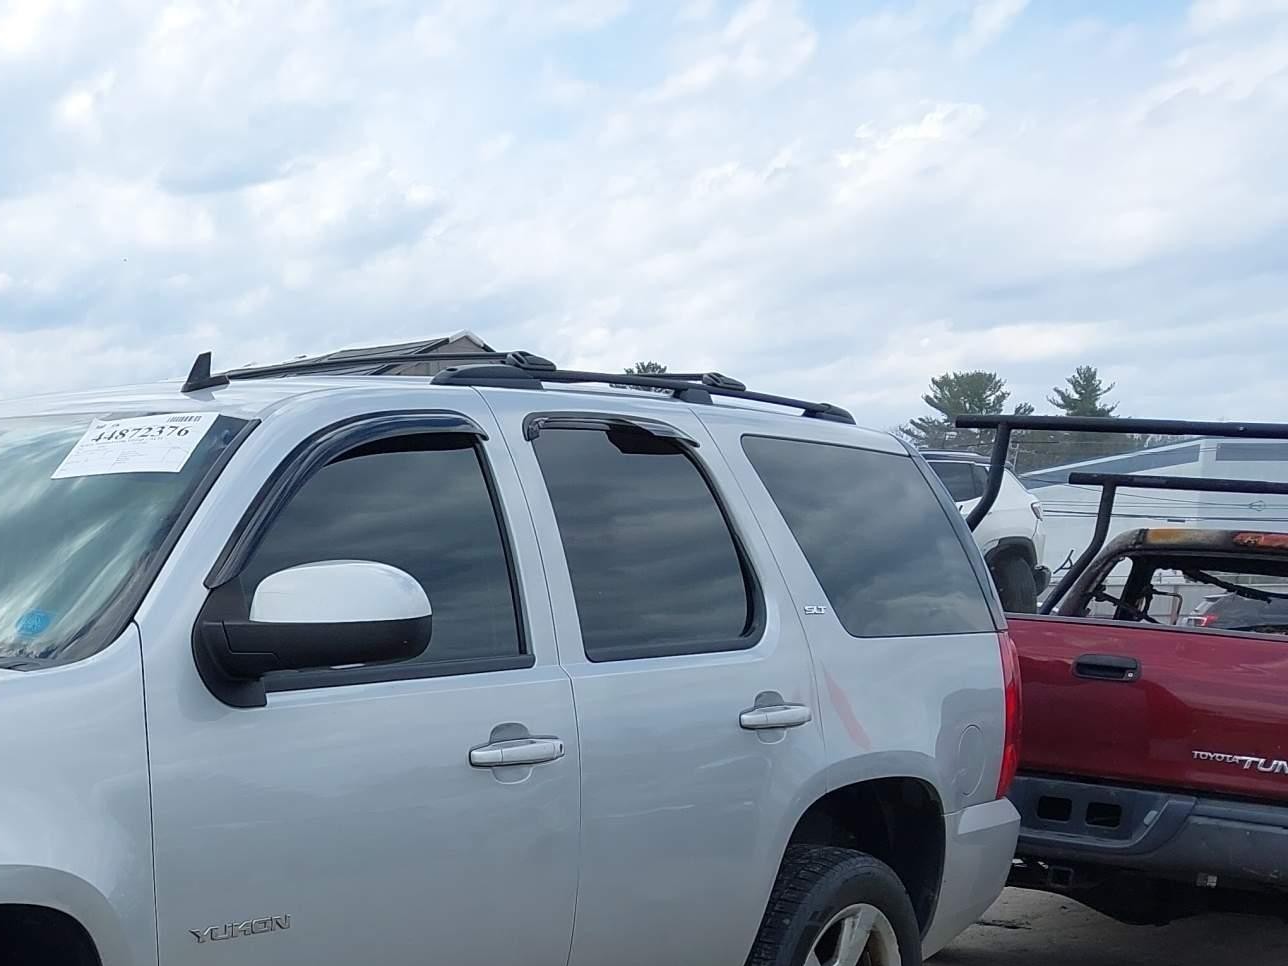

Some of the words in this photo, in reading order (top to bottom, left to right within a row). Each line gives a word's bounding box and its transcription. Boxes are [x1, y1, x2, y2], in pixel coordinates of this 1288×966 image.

[91, 425, 191, 442] 44872376
[804, 605, 827, 616] SLT
[1192, 750, 1239, 764] TOYOTA
[189, 913, 291, 944] YUKON
